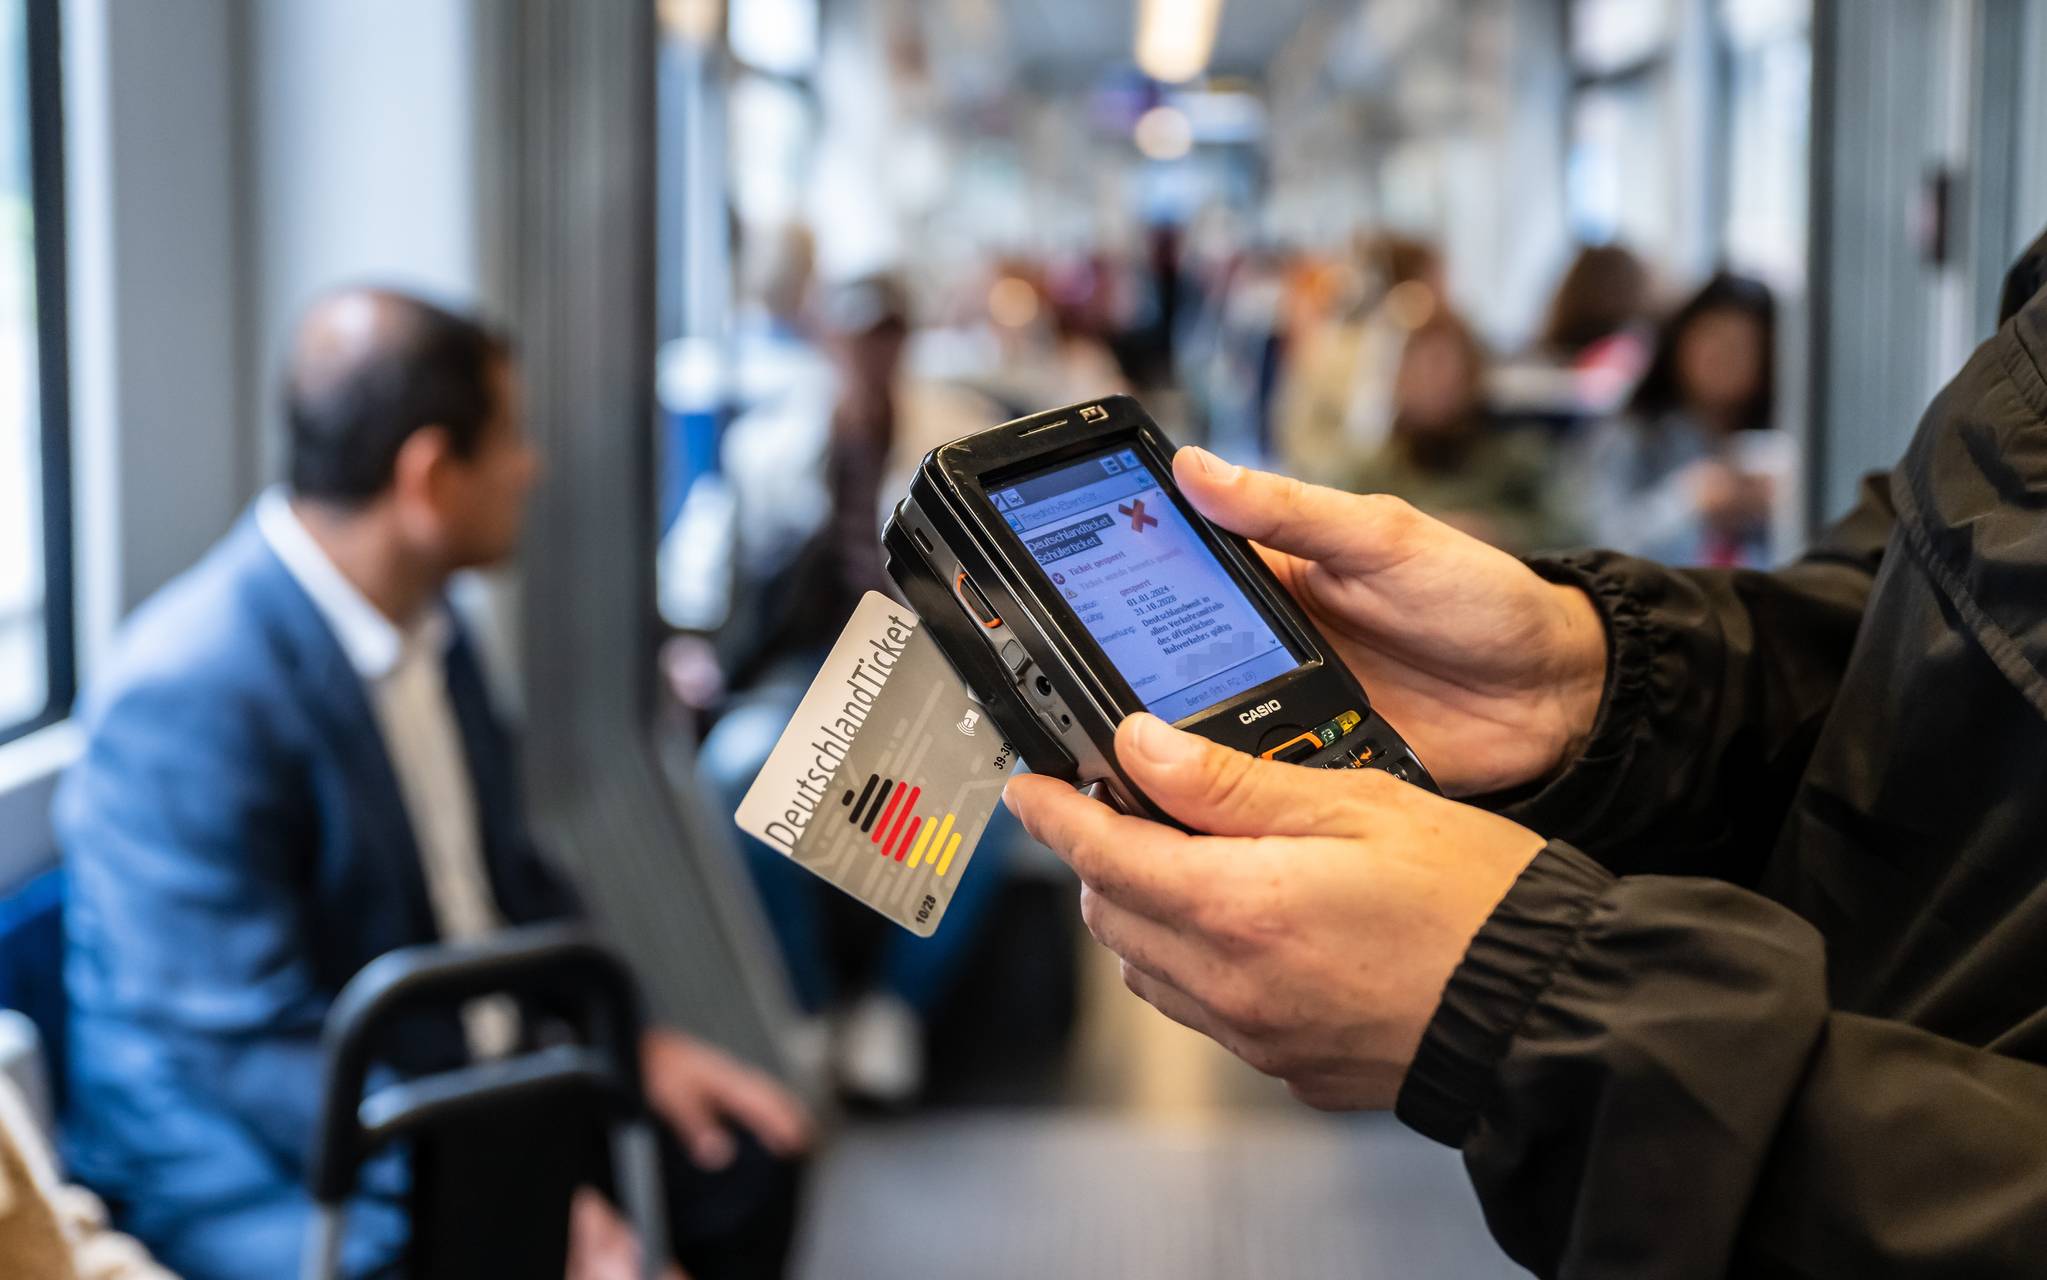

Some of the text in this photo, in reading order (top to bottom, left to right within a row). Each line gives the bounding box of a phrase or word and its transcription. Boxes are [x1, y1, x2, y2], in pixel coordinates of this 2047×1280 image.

[1028, 516, 1111, 553] Deutschlandticket
[1036, 536, 1098, 565] Schülerticket
[1127, 586, 1169, 607] 01.01.2024
[1150, 625, 1168, 637] allen
[1157, 636, 1171, 646] des
[1164, 632, 1210, 655] Nahverkehrs
[1239, 699, 1281, 724] CASIO
[765, 614, 916, 849] DeutschlandTicket
[916, 894, 936, 923] 10/28
